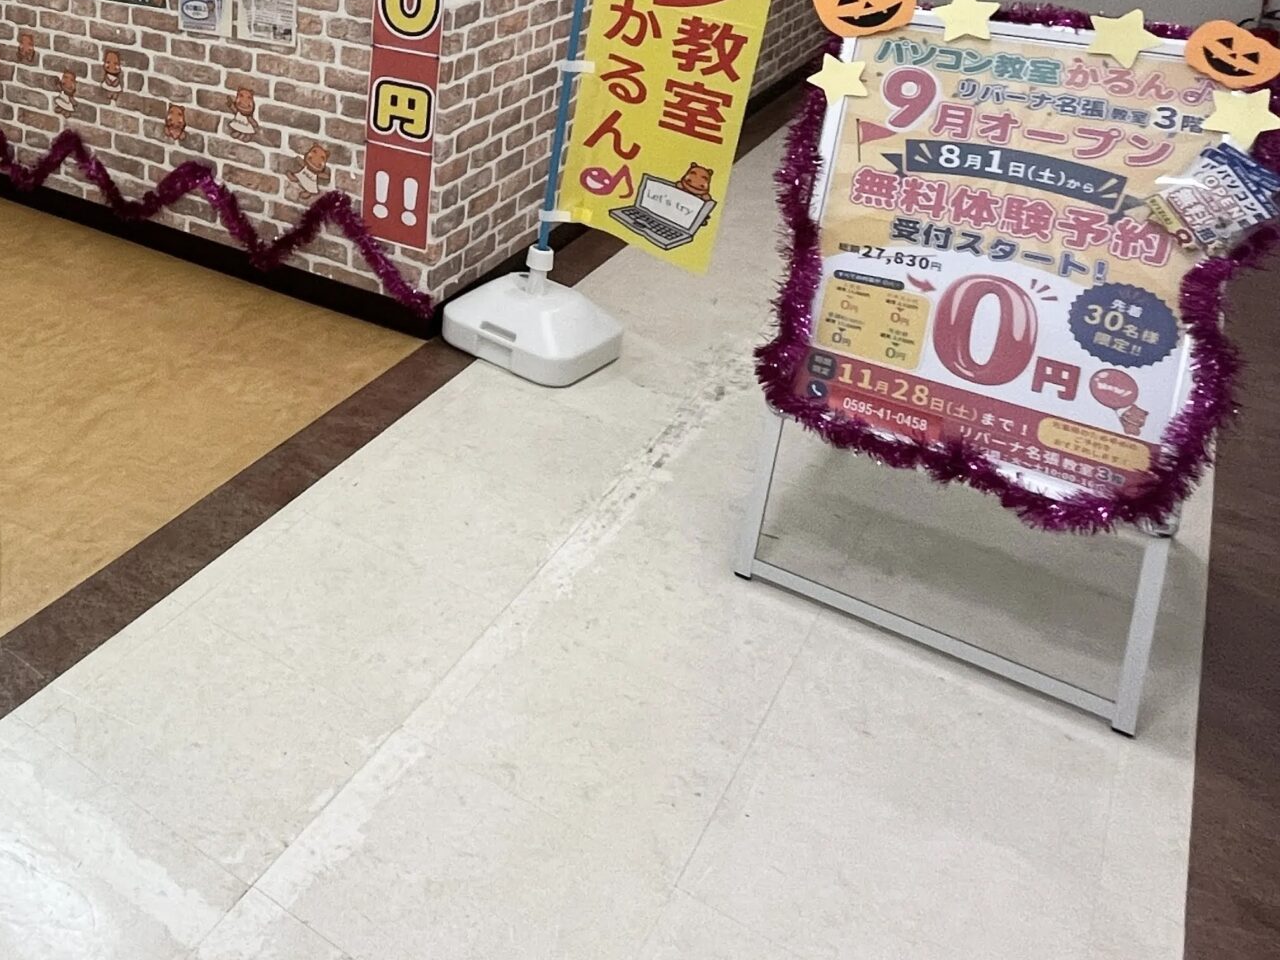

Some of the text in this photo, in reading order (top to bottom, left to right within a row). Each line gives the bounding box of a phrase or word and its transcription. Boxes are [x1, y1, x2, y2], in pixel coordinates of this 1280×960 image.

[881, 66, 1175, 167] 9月オープン
[646, 189, 694, 216] Let's try
[852, 167, 1172, 266] 無料体験予約
[890, 216, 1109, 284] 受付スタート!
[932, 273, 1081, 401] 0円
[842, 397, 929, 431] 0595-41-0458
